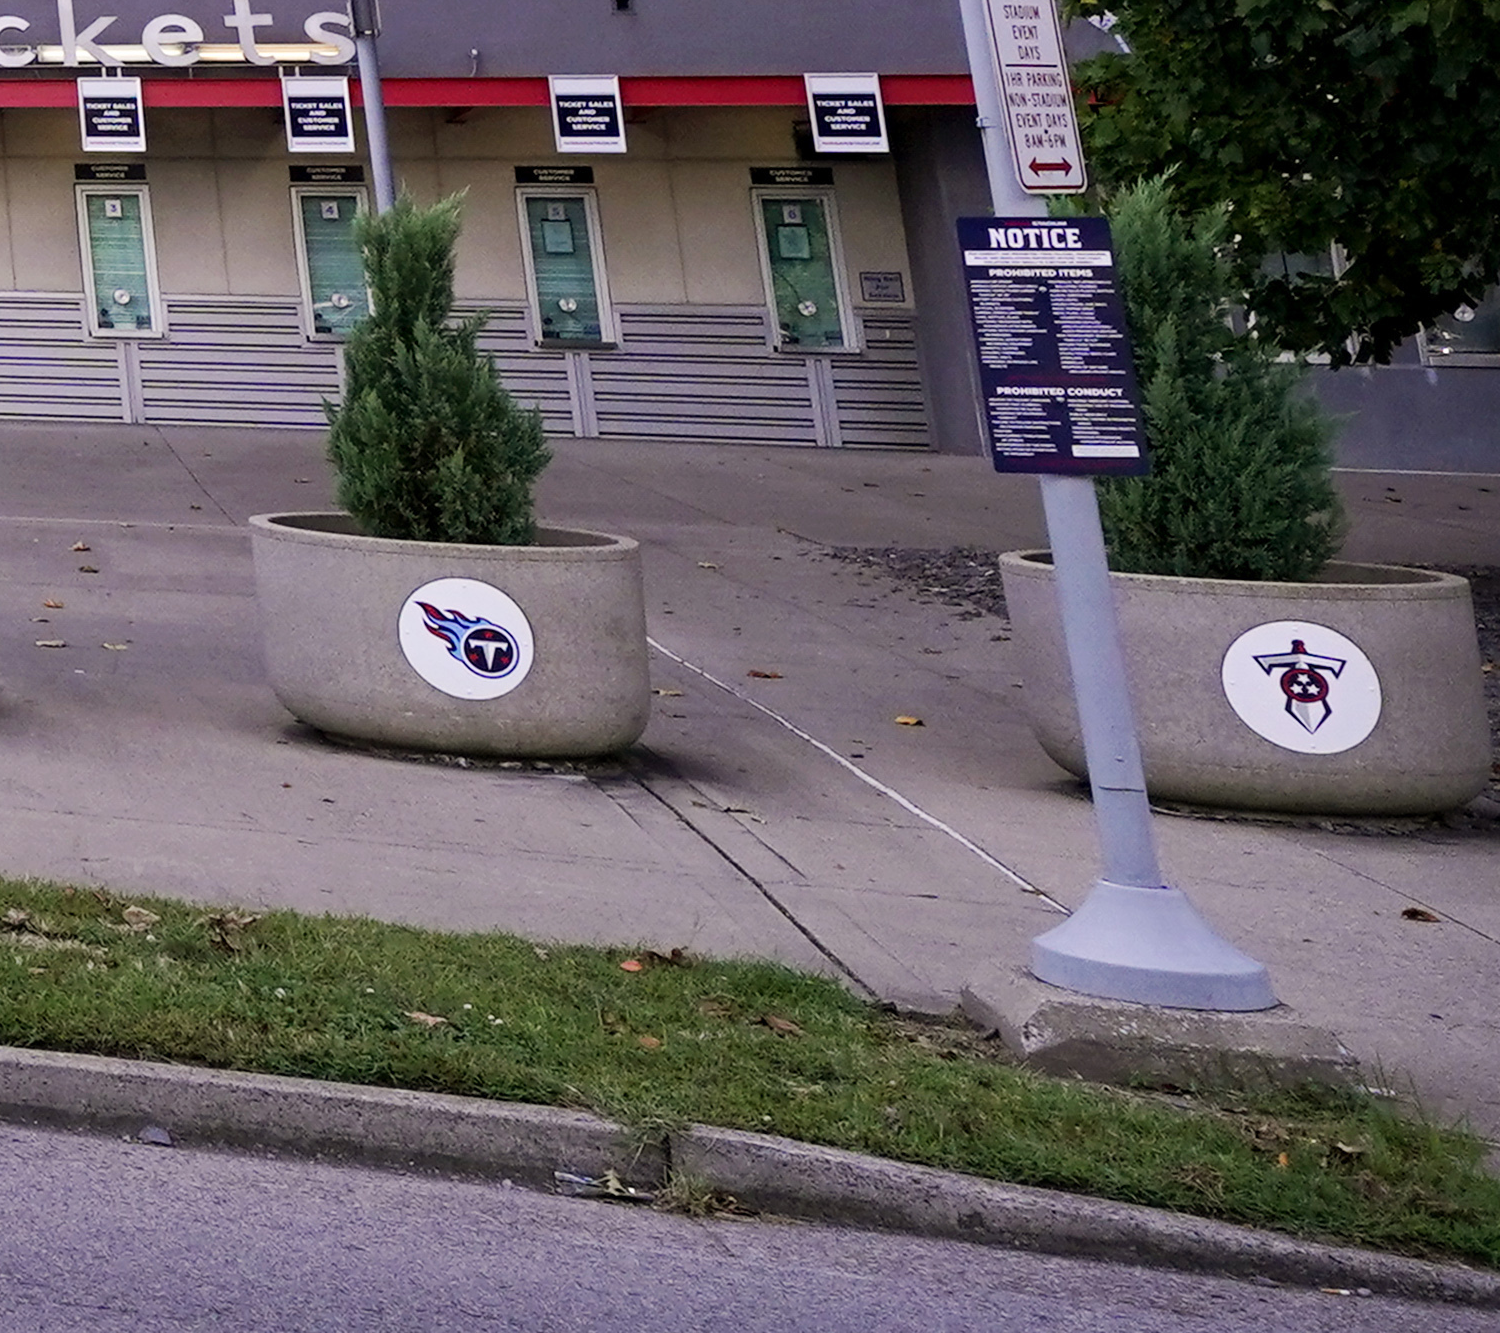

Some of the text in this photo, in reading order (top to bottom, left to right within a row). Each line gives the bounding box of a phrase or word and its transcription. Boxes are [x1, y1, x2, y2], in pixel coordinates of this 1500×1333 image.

[1003, 5, 1041, 20] STADIUM
[1012, 25, 1038, 40] EVENT
[1018, 46, 1041, 60] DAYS
[1011, 73, 1023, 87] HR
[1027, 73, 1062, 87] PARKING
[1008, 93, 1067, 107] NON-STADIUM
[831, 123, 867, 131] SERVICE
[1016, 113, 1067, 128] EVENT DAYS
[1025, 134, 1067, 148] 8AM-6PM
[110, 204, 116, 212] 3
[988, 228, 1082, 249] NOTICE
[989, 269, 1093, 277] PROHIBITED ITEMS
[996, 387, 1123, 397] PROHIBITED CONDUCT
